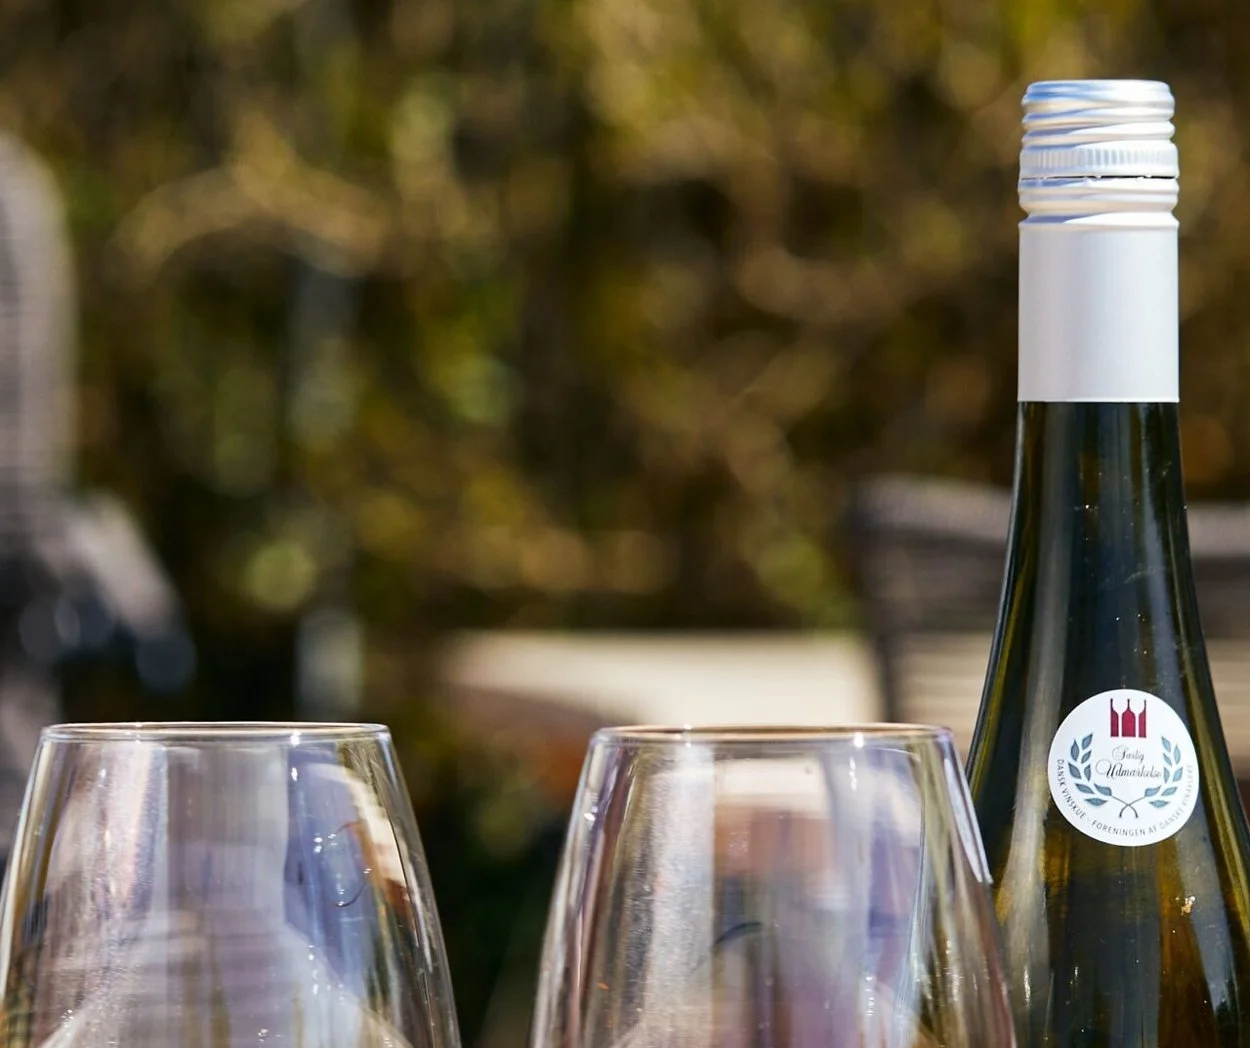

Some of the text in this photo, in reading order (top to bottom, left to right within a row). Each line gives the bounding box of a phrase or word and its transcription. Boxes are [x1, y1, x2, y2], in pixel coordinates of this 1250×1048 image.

[1057, 759, 1066, 787] DANSK
[1062, 788, 1086, 818] VINSKUE
[1091, 820, 1146, 836] FORENINGEN
[1148, 825, 1157, 834] AF
